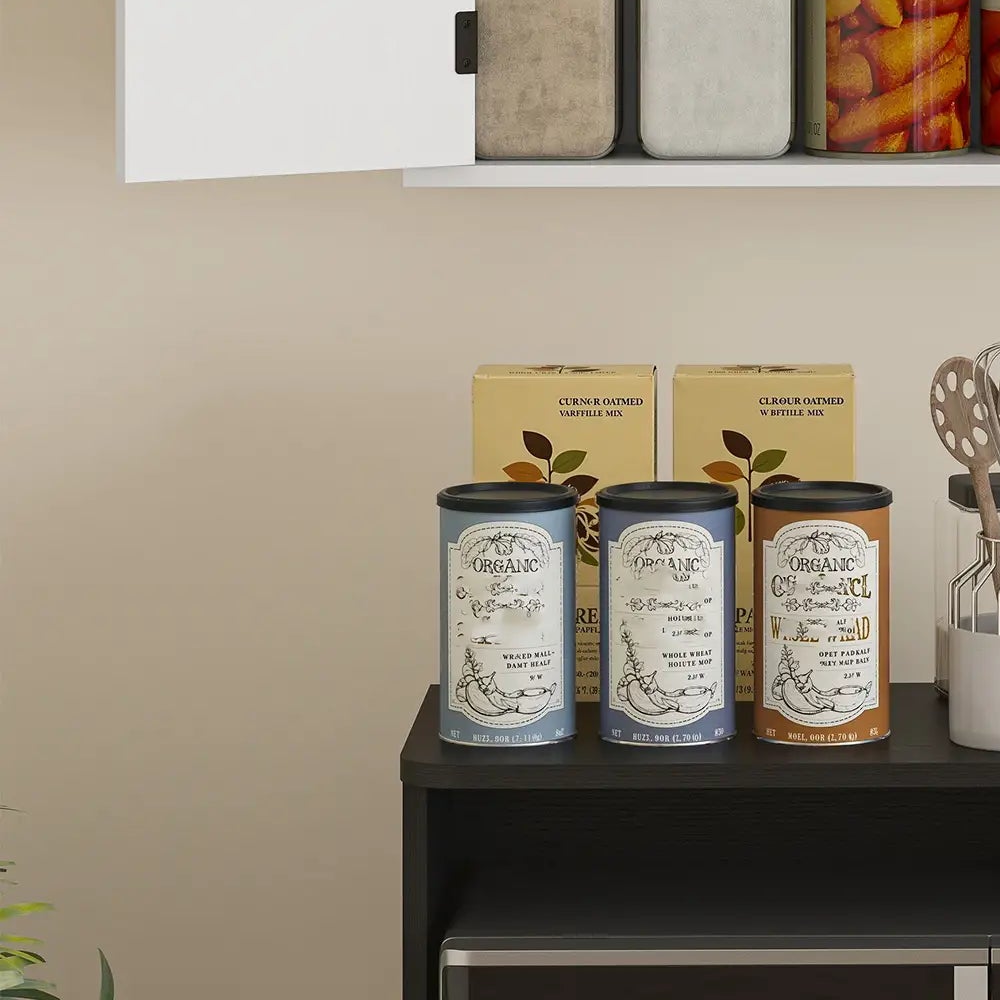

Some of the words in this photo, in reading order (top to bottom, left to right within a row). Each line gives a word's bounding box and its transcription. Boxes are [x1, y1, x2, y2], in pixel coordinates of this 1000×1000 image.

[602, 397, 644, 406] OATMED
[802, 397, 845, 405] OATMED
[760, 409, 769, 417] W
[807, 409, 825, 417] MIX
[576, 607, 601, 624] RE
[689, 650, 713, 658] WHEAT
